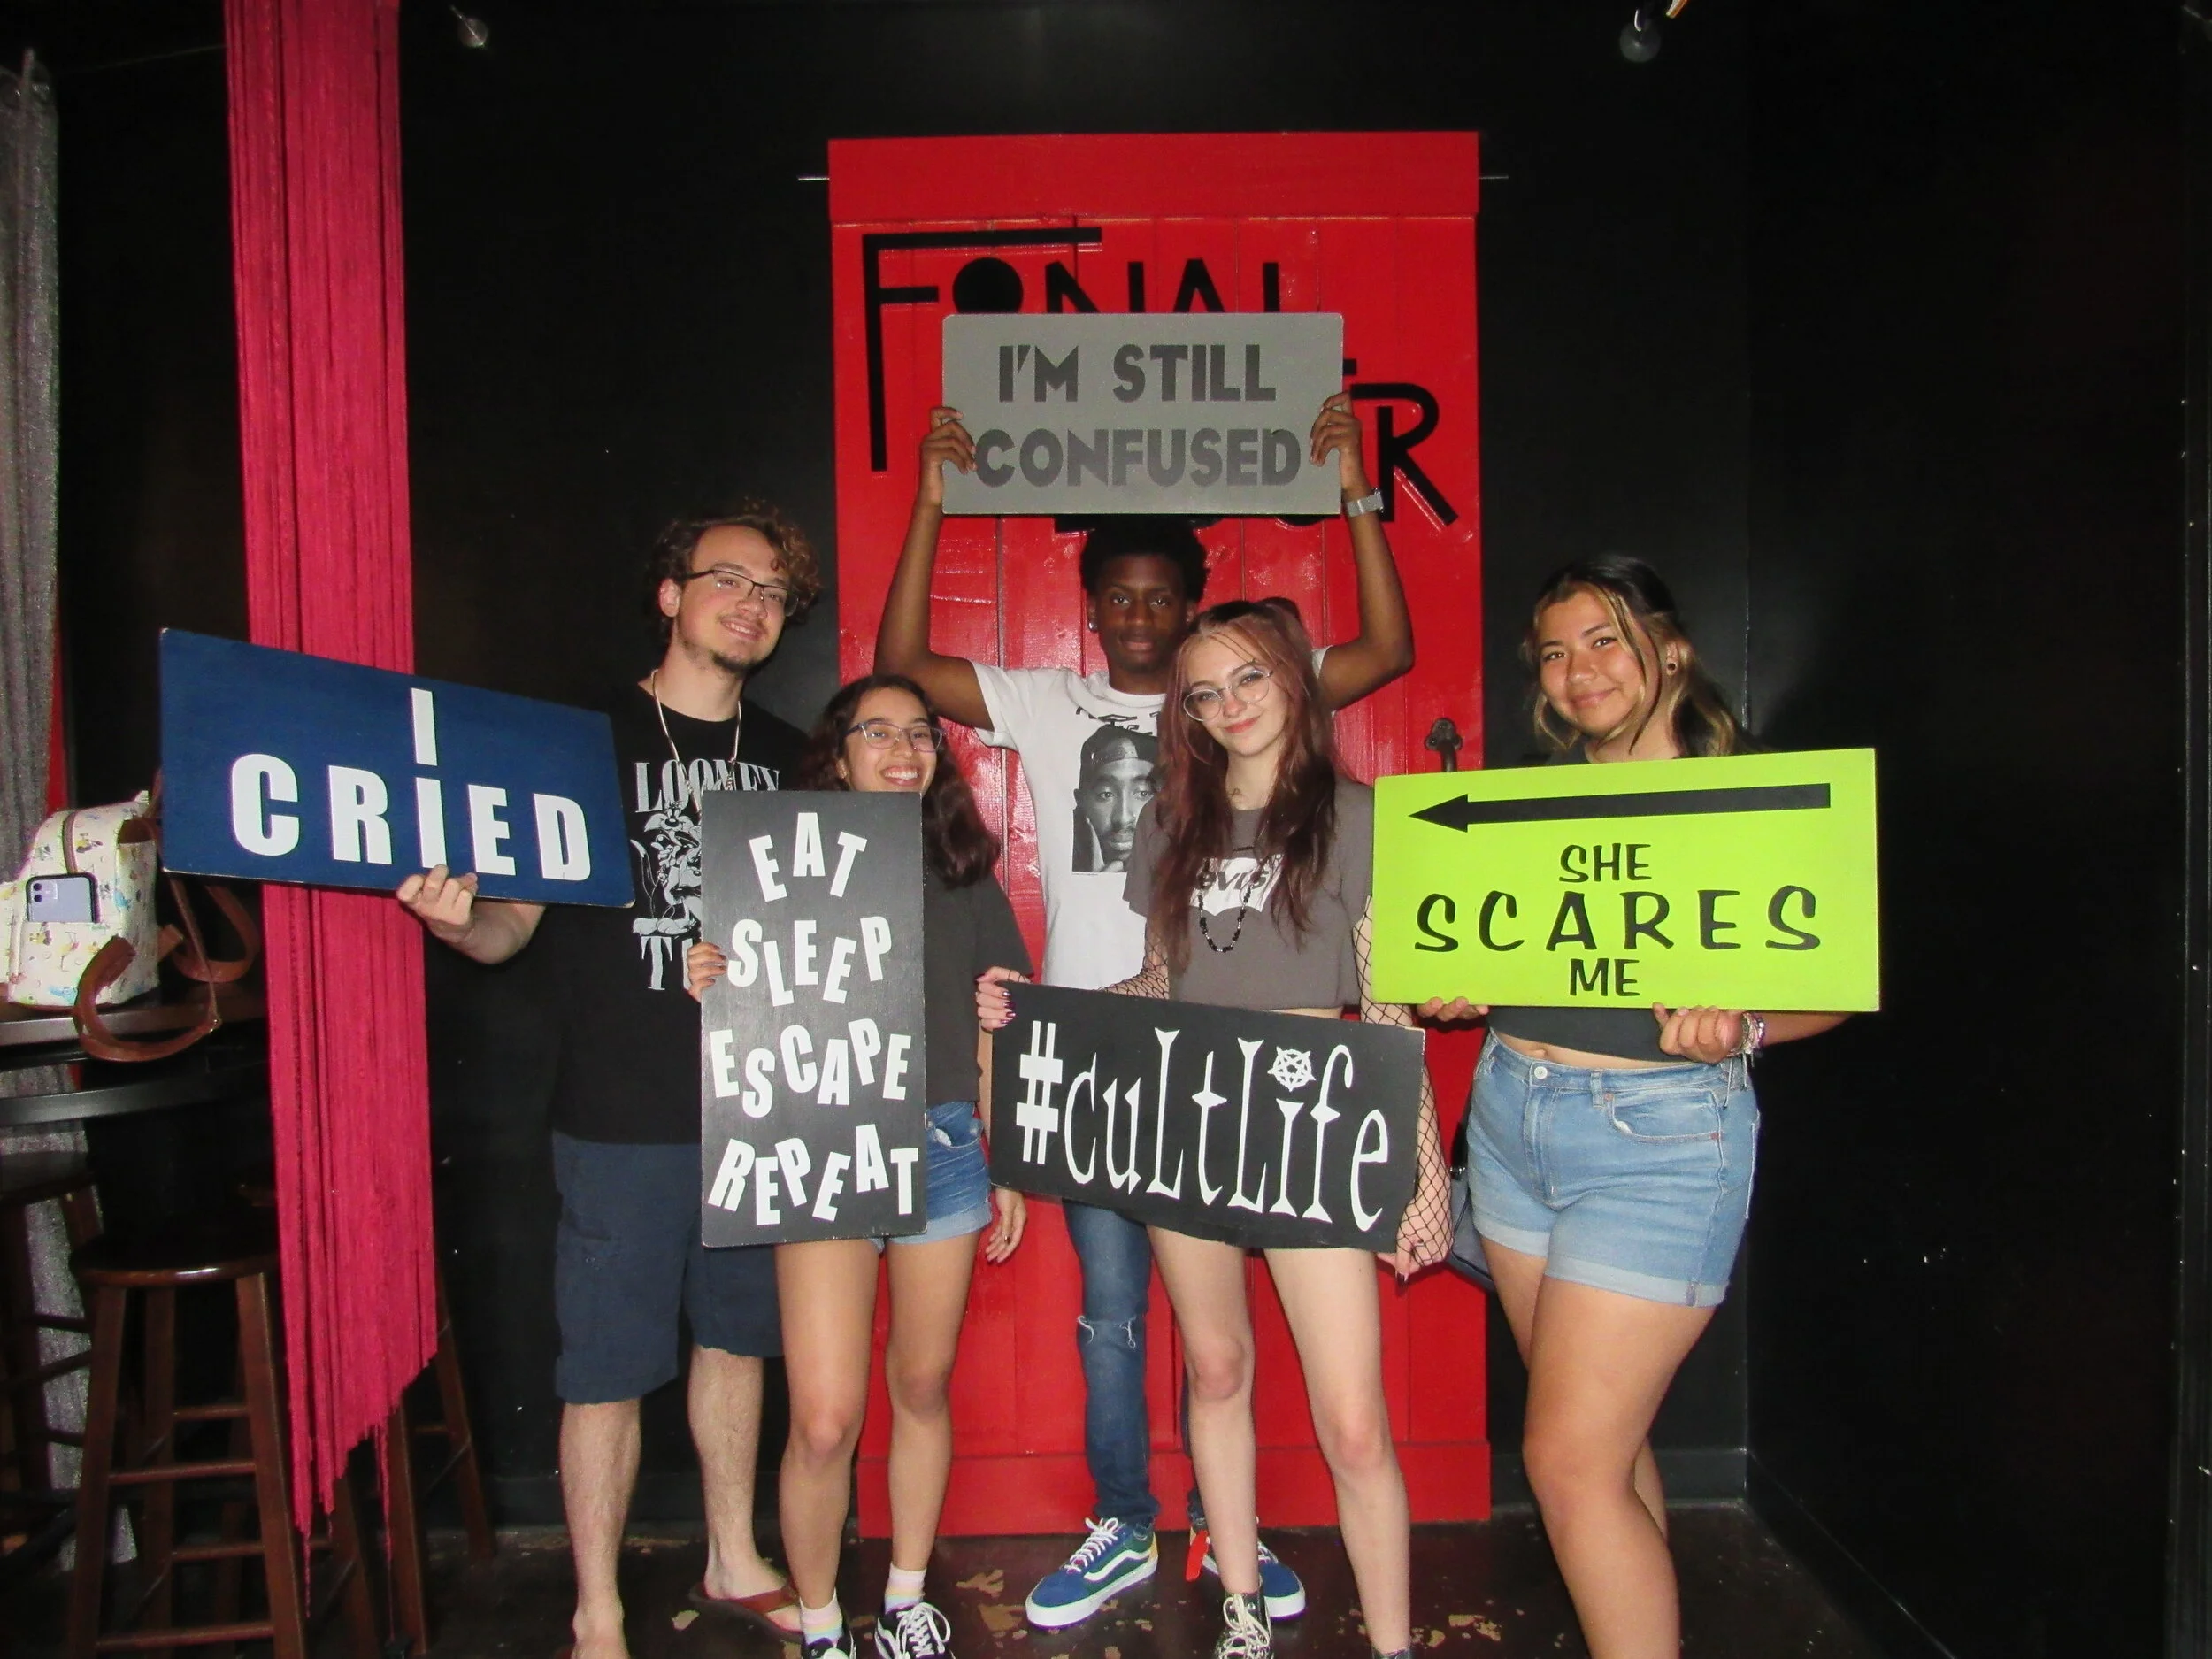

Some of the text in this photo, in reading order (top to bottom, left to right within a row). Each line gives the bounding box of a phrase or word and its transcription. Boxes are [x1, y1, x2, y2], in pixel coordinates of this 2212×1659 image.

[999, 344, 1276, 402] I'M STILL
[975, 427, 1301, 488] CONFUSED
[411, 687, 438, 766] I
[231, 754, 592, 883] CRIED
[749, 812, 868, 902] EAT
[1559, 843, 1652, 883] SHE
[1415, 886, 1821, 952] SCARES
[727, 916, 893, 1007] SLEEP
[1569, 958, 1640, 997] ME
[709, 1018, 912, 1118] ESCAPE
[708, 1124, 918, 1225] REPEAT
